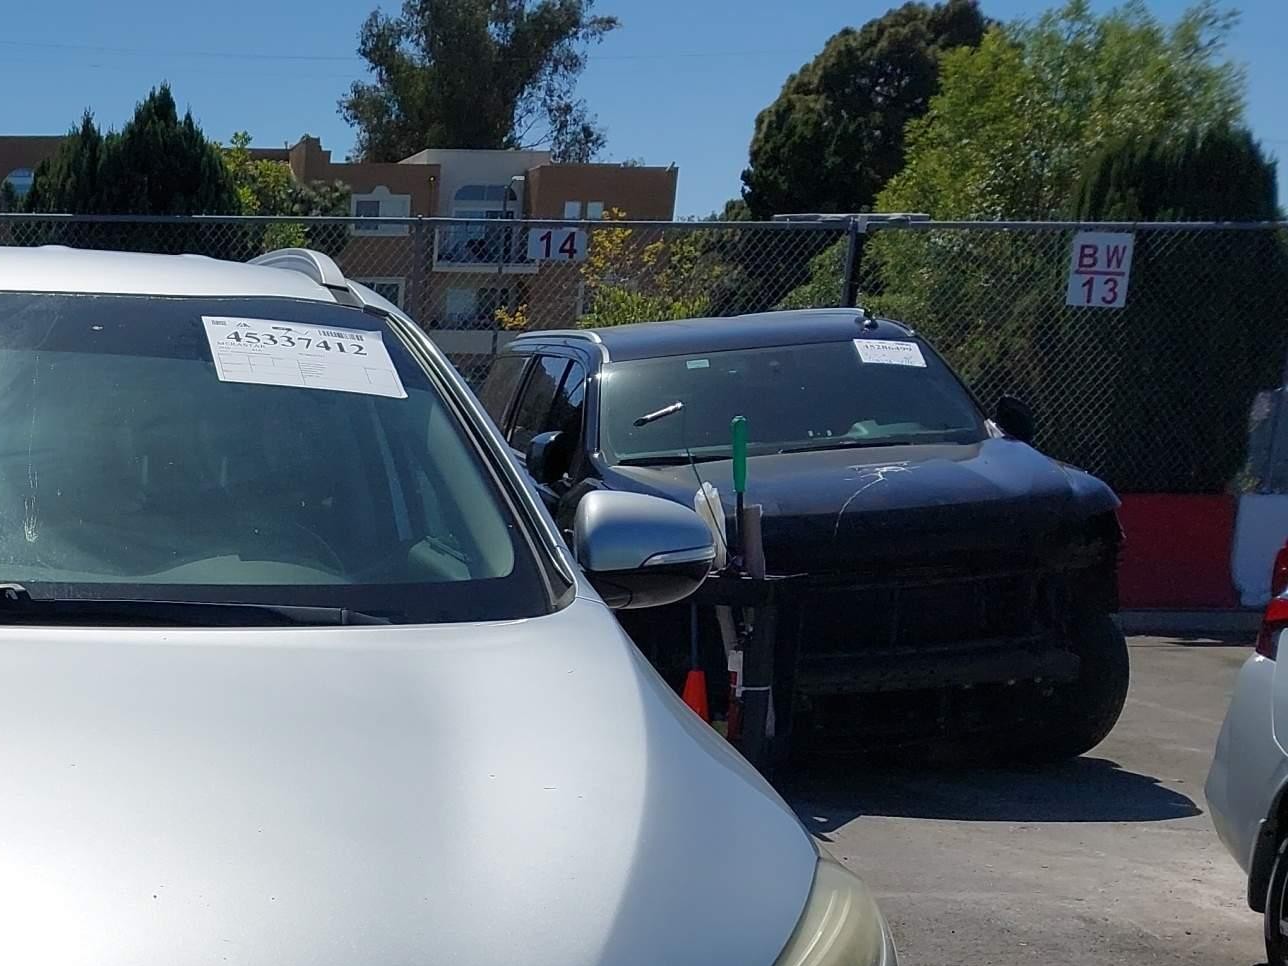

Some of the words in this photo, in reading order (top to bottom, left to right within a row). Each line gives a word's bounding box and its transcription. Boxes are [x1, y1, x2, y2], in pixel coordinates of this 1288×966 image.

[539, 230, 578, 259] 14
[1080, 276, 1119, 305] 13
[225, 330, 368, 357] 45337412
